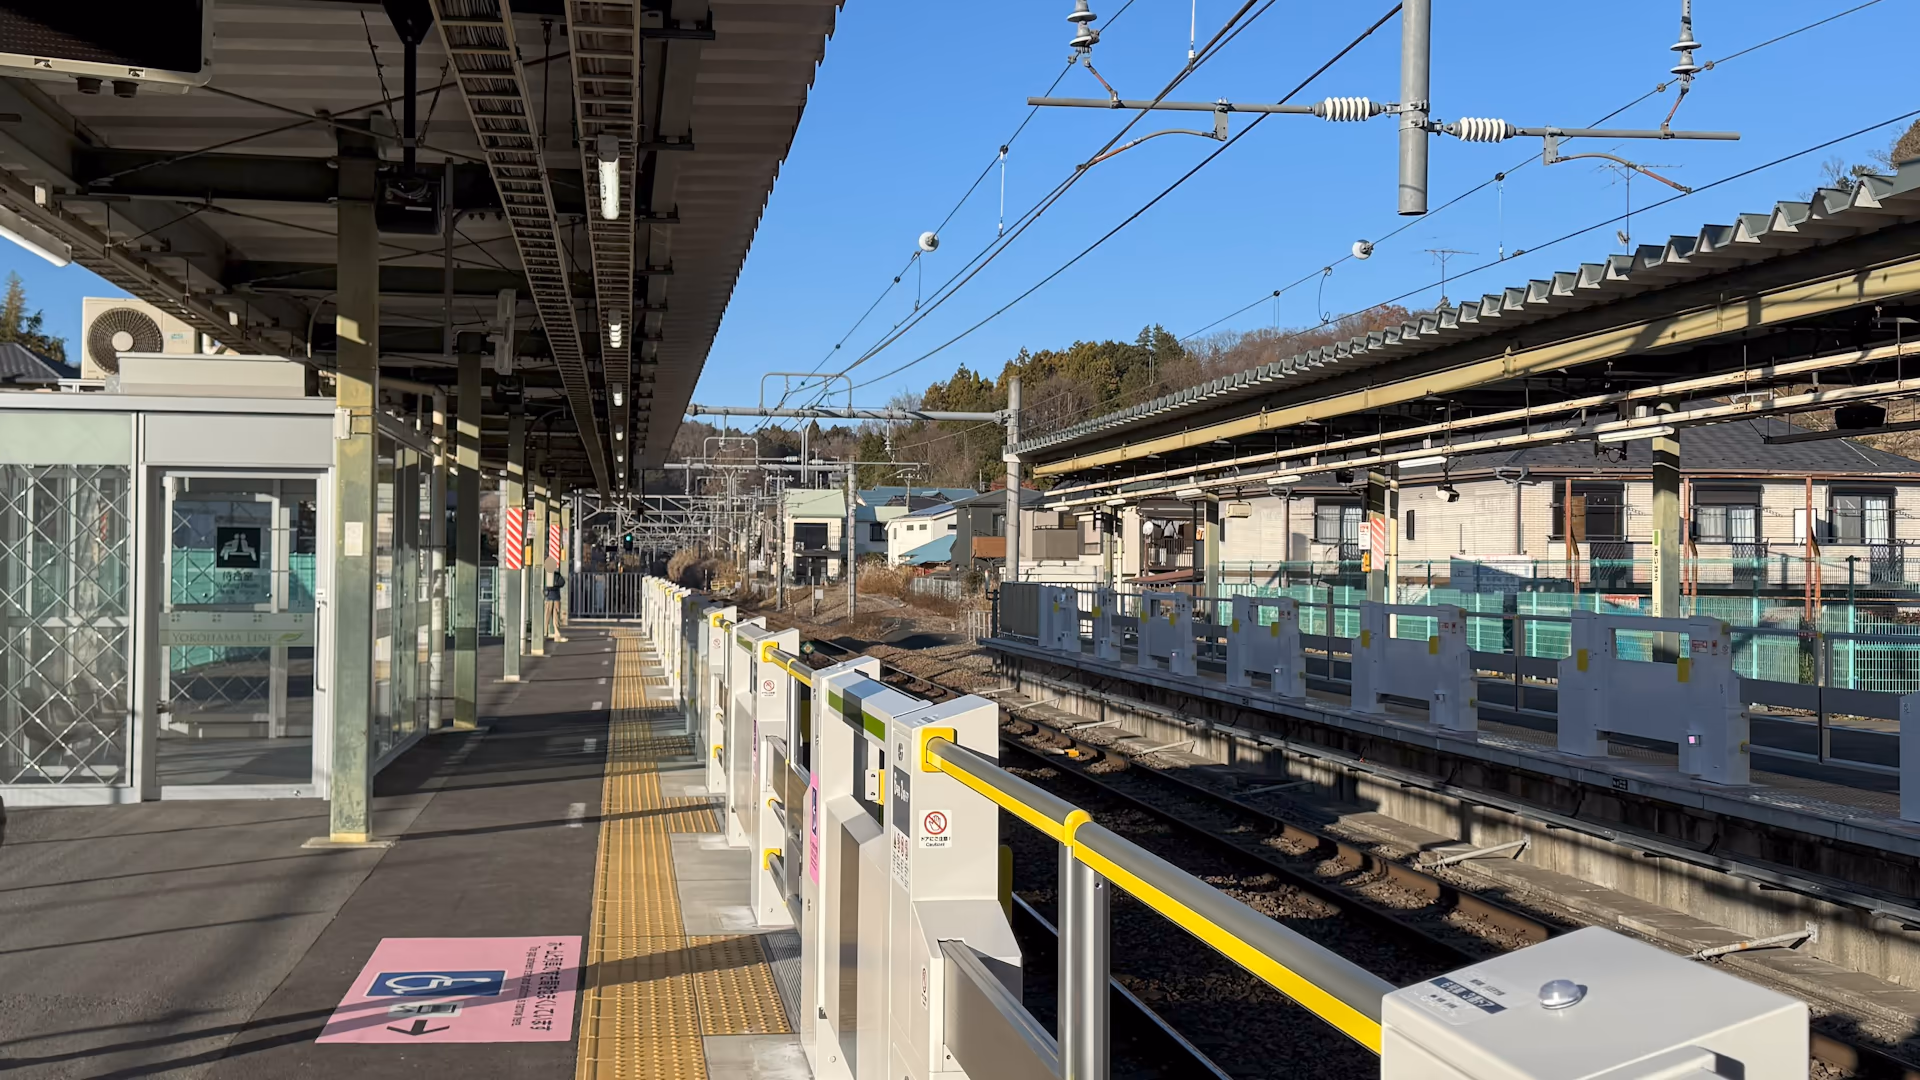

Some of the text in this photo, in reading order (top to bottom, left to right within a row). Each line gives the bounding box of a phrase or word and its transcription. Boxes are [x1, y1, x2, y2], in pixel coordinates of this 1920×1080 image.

[222, 570, 253, 582] 待合室
[172, 631, 273, 643] YOKOHAMA LINE
